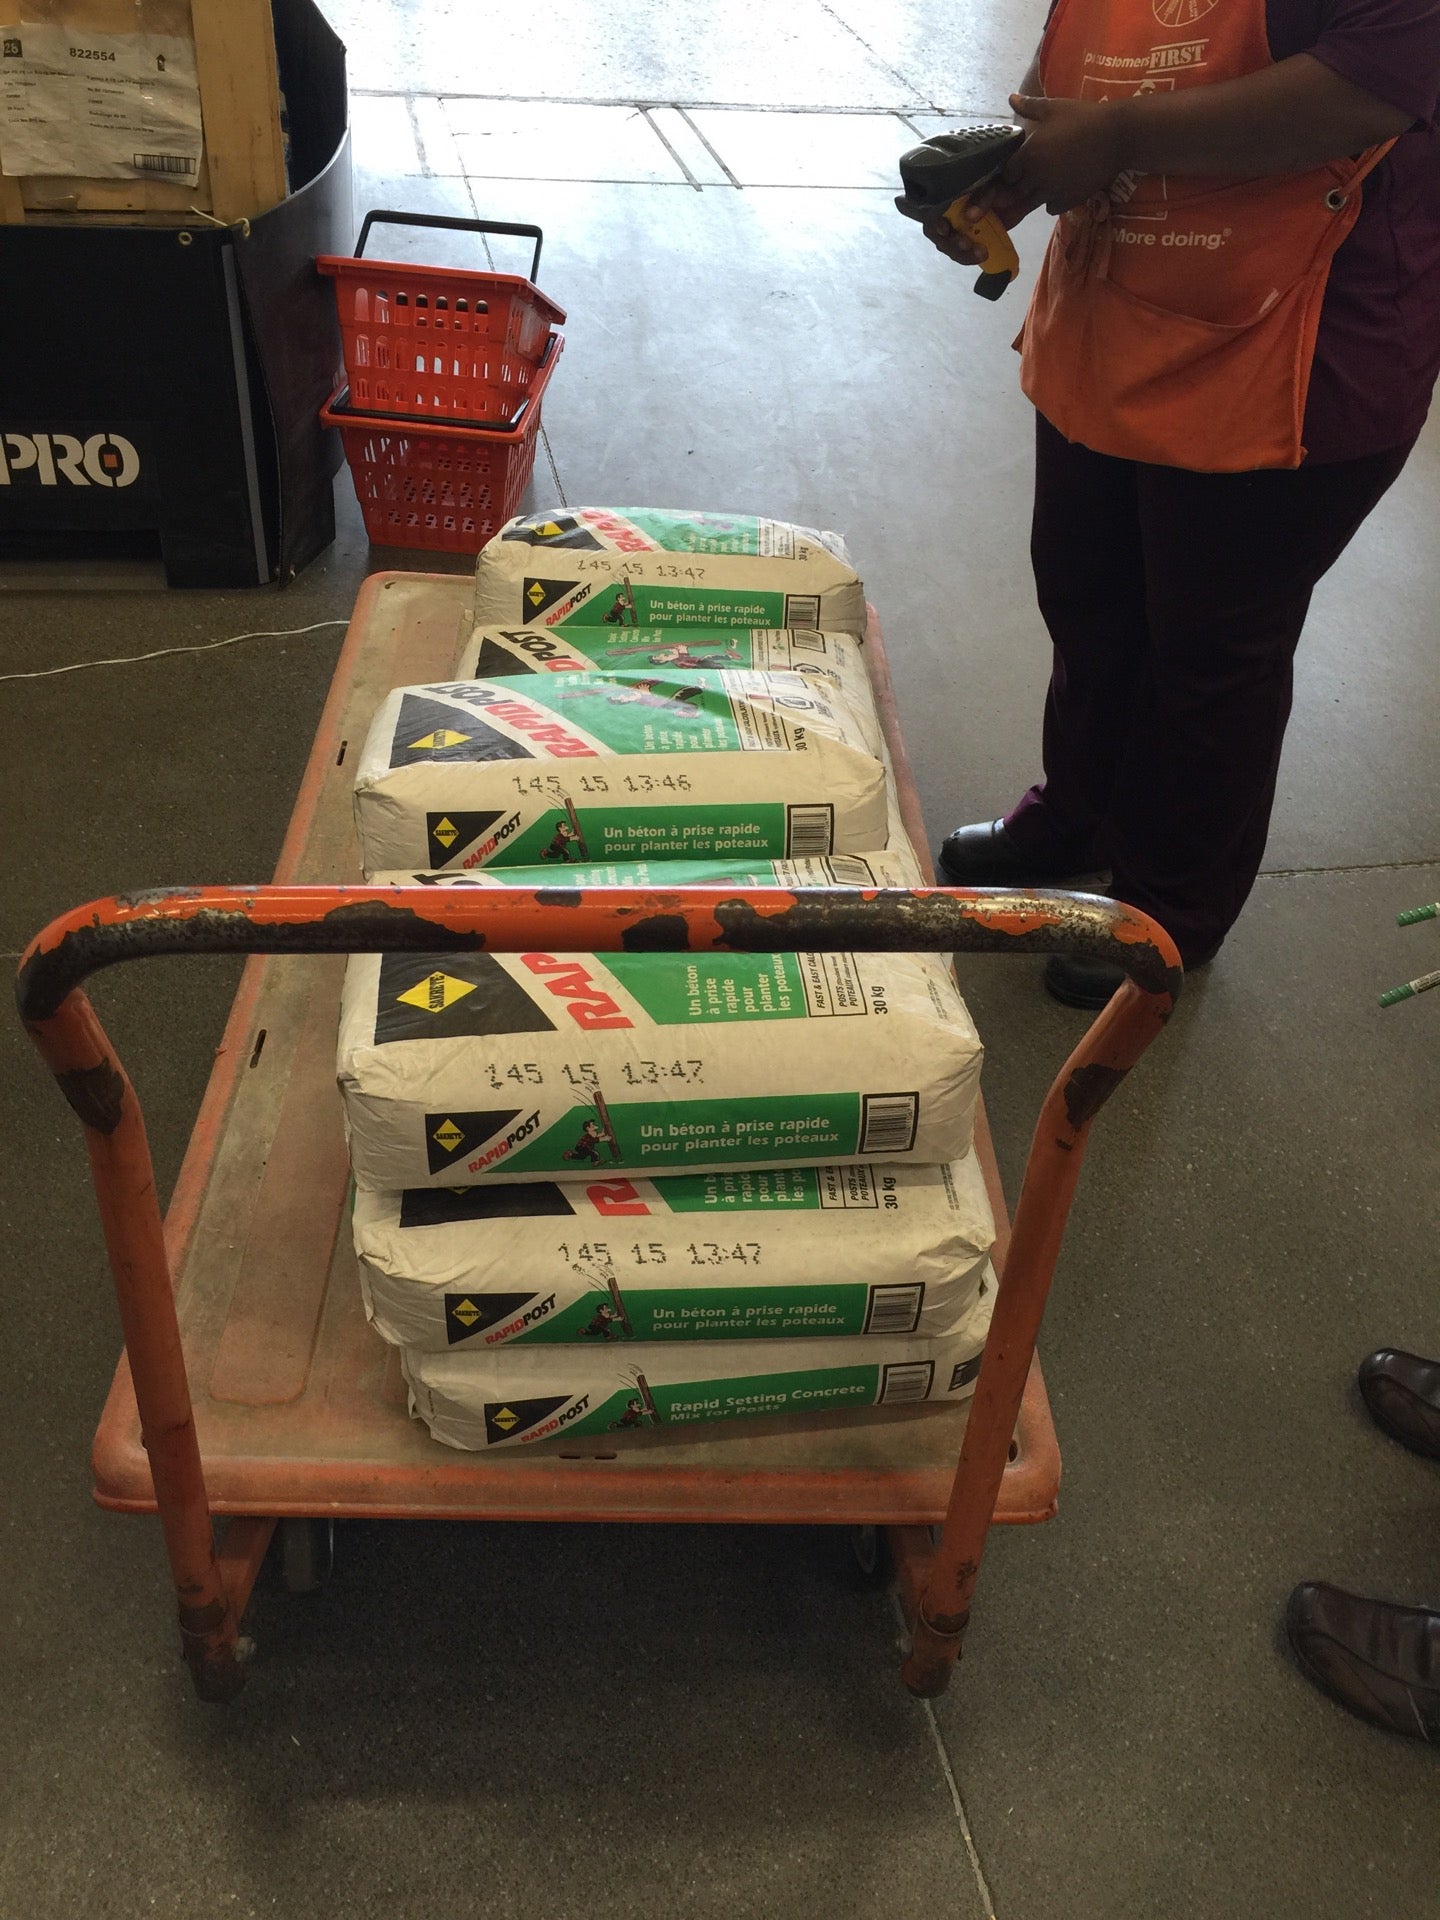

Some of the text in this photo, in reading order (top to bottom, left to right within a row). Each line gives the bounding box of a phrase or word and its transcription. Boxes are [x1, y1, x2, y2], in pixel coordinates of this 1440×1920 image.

[69, 47, 116, 61] 822554
[577, 559, 612, 571] 145
[622, 562, 643, 575] 15
[545, 583, 592, 626] RAPIDPOST
[650, 600, 765, 616] Un béton à prise rapide
[649, 612, 770, 627] pour planter les poteaux
[424, 683, 598, 758] RAPIDPOST
[793, 727, 805, 742] kg
[512, 776, 561, 795] 145
[580, 775, 609, 792] 15
[462, 811, 521, 869] RAPIDPOST
[604, 823, 760, 840] Un béton à prise rapide
[604, 838, 768, 854] pour planter les poteaux
[771, 953, 792, 1012] les poteaux
[810, 968, 820, 983] EASY
[429, 974, 445, 1010] SAKRETE
[687, 965, 702, 1016] Un béton
[705, 977, 723, 1015] à prise
[721, 978, 740, 1014] rapide
[742, 986, 760, 1013] pour
[758, 973, 778, 1012] planter
[814, 991, 825, 1008] FAST
[836, 986, 847, 1007] POSTS
[845, 979, 858, 1007] POTEAUX
[871, 985, 888, 1015] 30 kg
[484, 1060, 704, 1089] 145 15 13:47
[640, 1117, 830, 1138] Un béton à prise rapide
[468, 1110, 541, 1173] RAPIDPOST
[641, 1133, 839, 1154] pour planter les poteaux
[704, 1186, 718, 1204] Un
[758, 1175, 774, 1202] pour
[791, 1185, 804, 1202] les
[827, 1182, 838, 1201] FAST
[848, 1178, 859, 1201] POSTS
[857, 1169, 869, 1201] POTEAUX
[882, 1176, 898, 1209] 30 kg
[721, 1195, 735, 1203] à
[558, 1242, 761, 1265] 145 15 13:47
[485, 1293, 556, 1345] RAPIDPOST
[653, 1303, 837, 1319] Un béton à prise rapide
[653, 1316, 845, 1331] pour planter les poteaux
[670, 1384, 866, 1413] Rapid Setting Concrete
[521, 1394, 590, 1443] RAPIDPOST
[670, 1411, 701, 1421] Mix
[736, 1403, 781, 1414] Posts
